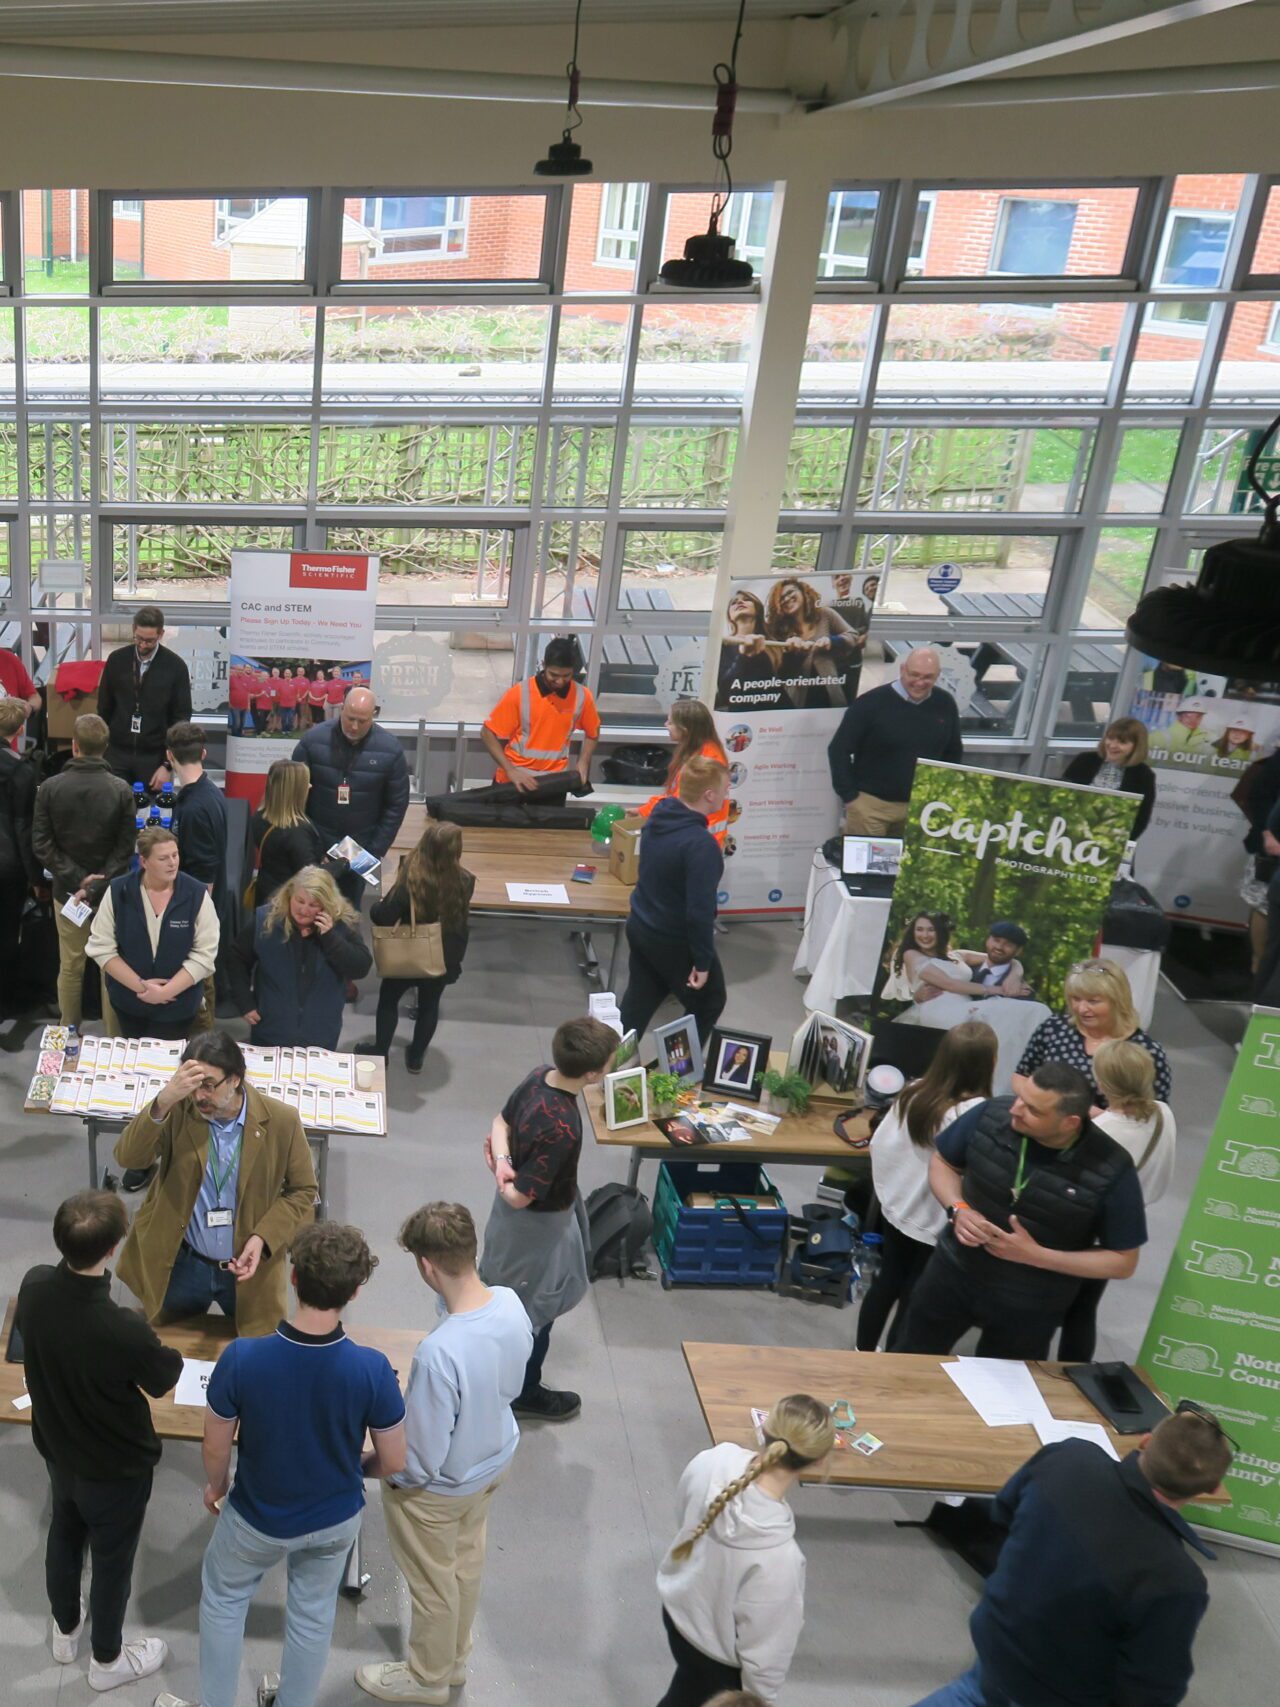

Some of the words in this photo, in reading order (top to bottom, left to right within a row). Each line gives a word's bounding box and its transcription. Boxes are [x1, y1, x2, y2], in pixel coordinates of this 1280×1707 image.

[241, 602, 262, 611] CAC
[264, 603, 282, 611] and
[284, 604, 312, 613] STEM
[730, 678, 741, 690] A
[743, 674, 846, 691] people-orientated
[729, 691, 781, 705] company
[1173, 751, 1207, 764] our
[1173, 820, 1188, 830] its
[920, 801, 1109, 867] Captcha
[995, 857, 1076, 880] PHOTOGRAPHY
[1077, 874, 1098, 884] LTD
[1209, 1313, 1249, 1326] County
